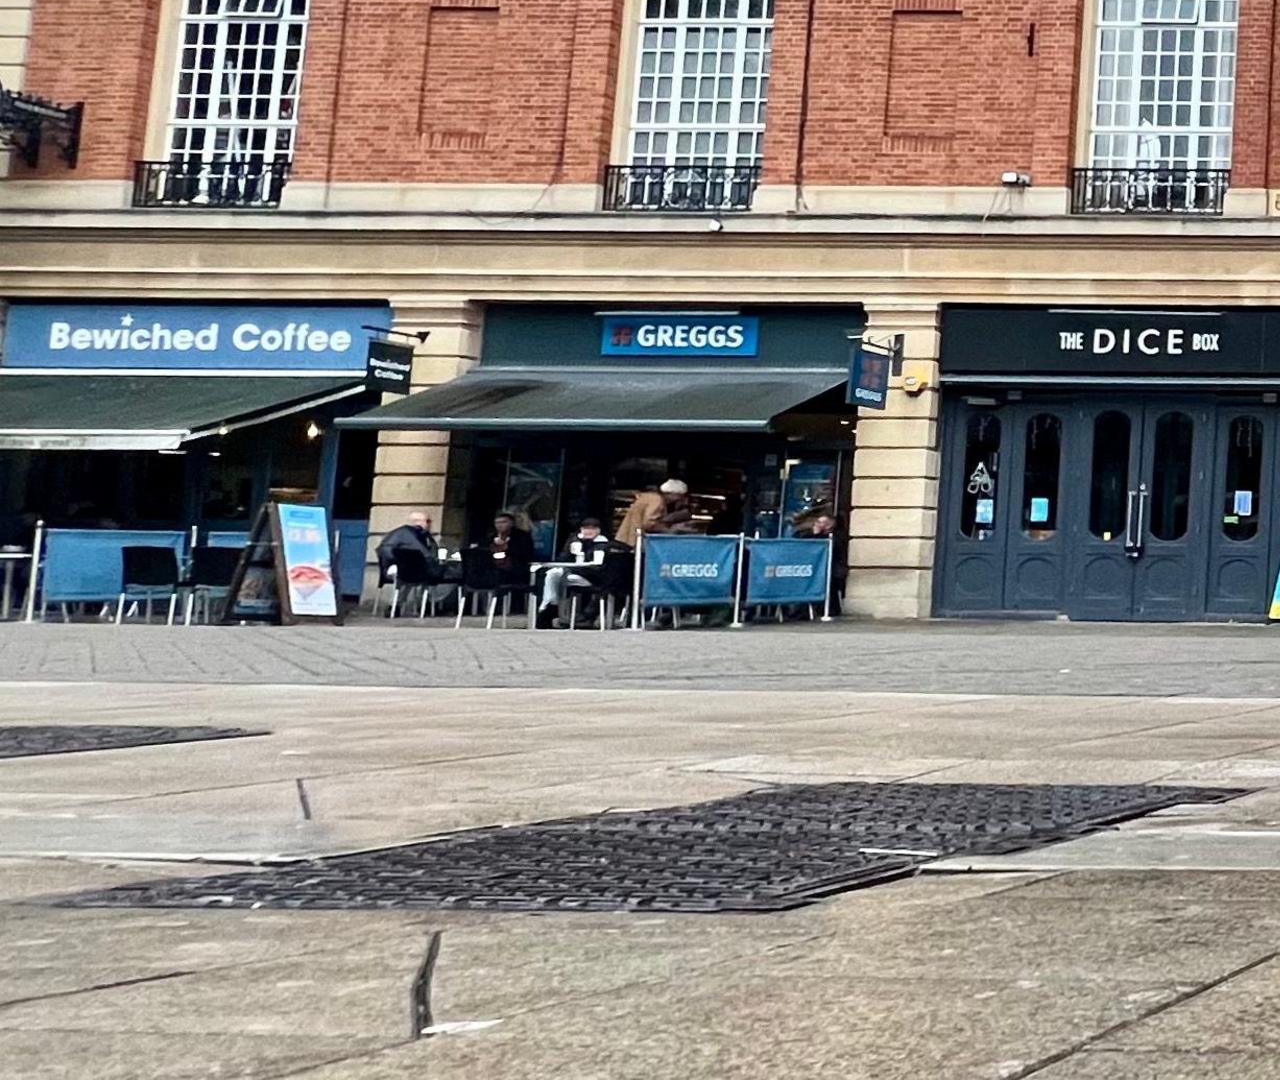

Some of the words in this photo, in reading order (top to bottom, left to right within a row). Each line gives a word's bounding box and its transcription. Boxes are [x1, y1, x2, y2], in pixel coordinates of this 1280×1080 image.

[49, 314, 219, 351] Bewiched
[232, 323, 351, 352] Coffee
[637, 324, 744, 348] GREGGS
[1059, 331, 1084, 350] THE
[1093, 328, 1184, 355] DICE
[1192, 333, 1220, 351] BOX
[671, 563, 719, 578] GREGGS
[775, 564, 813, 578] GREGGS
